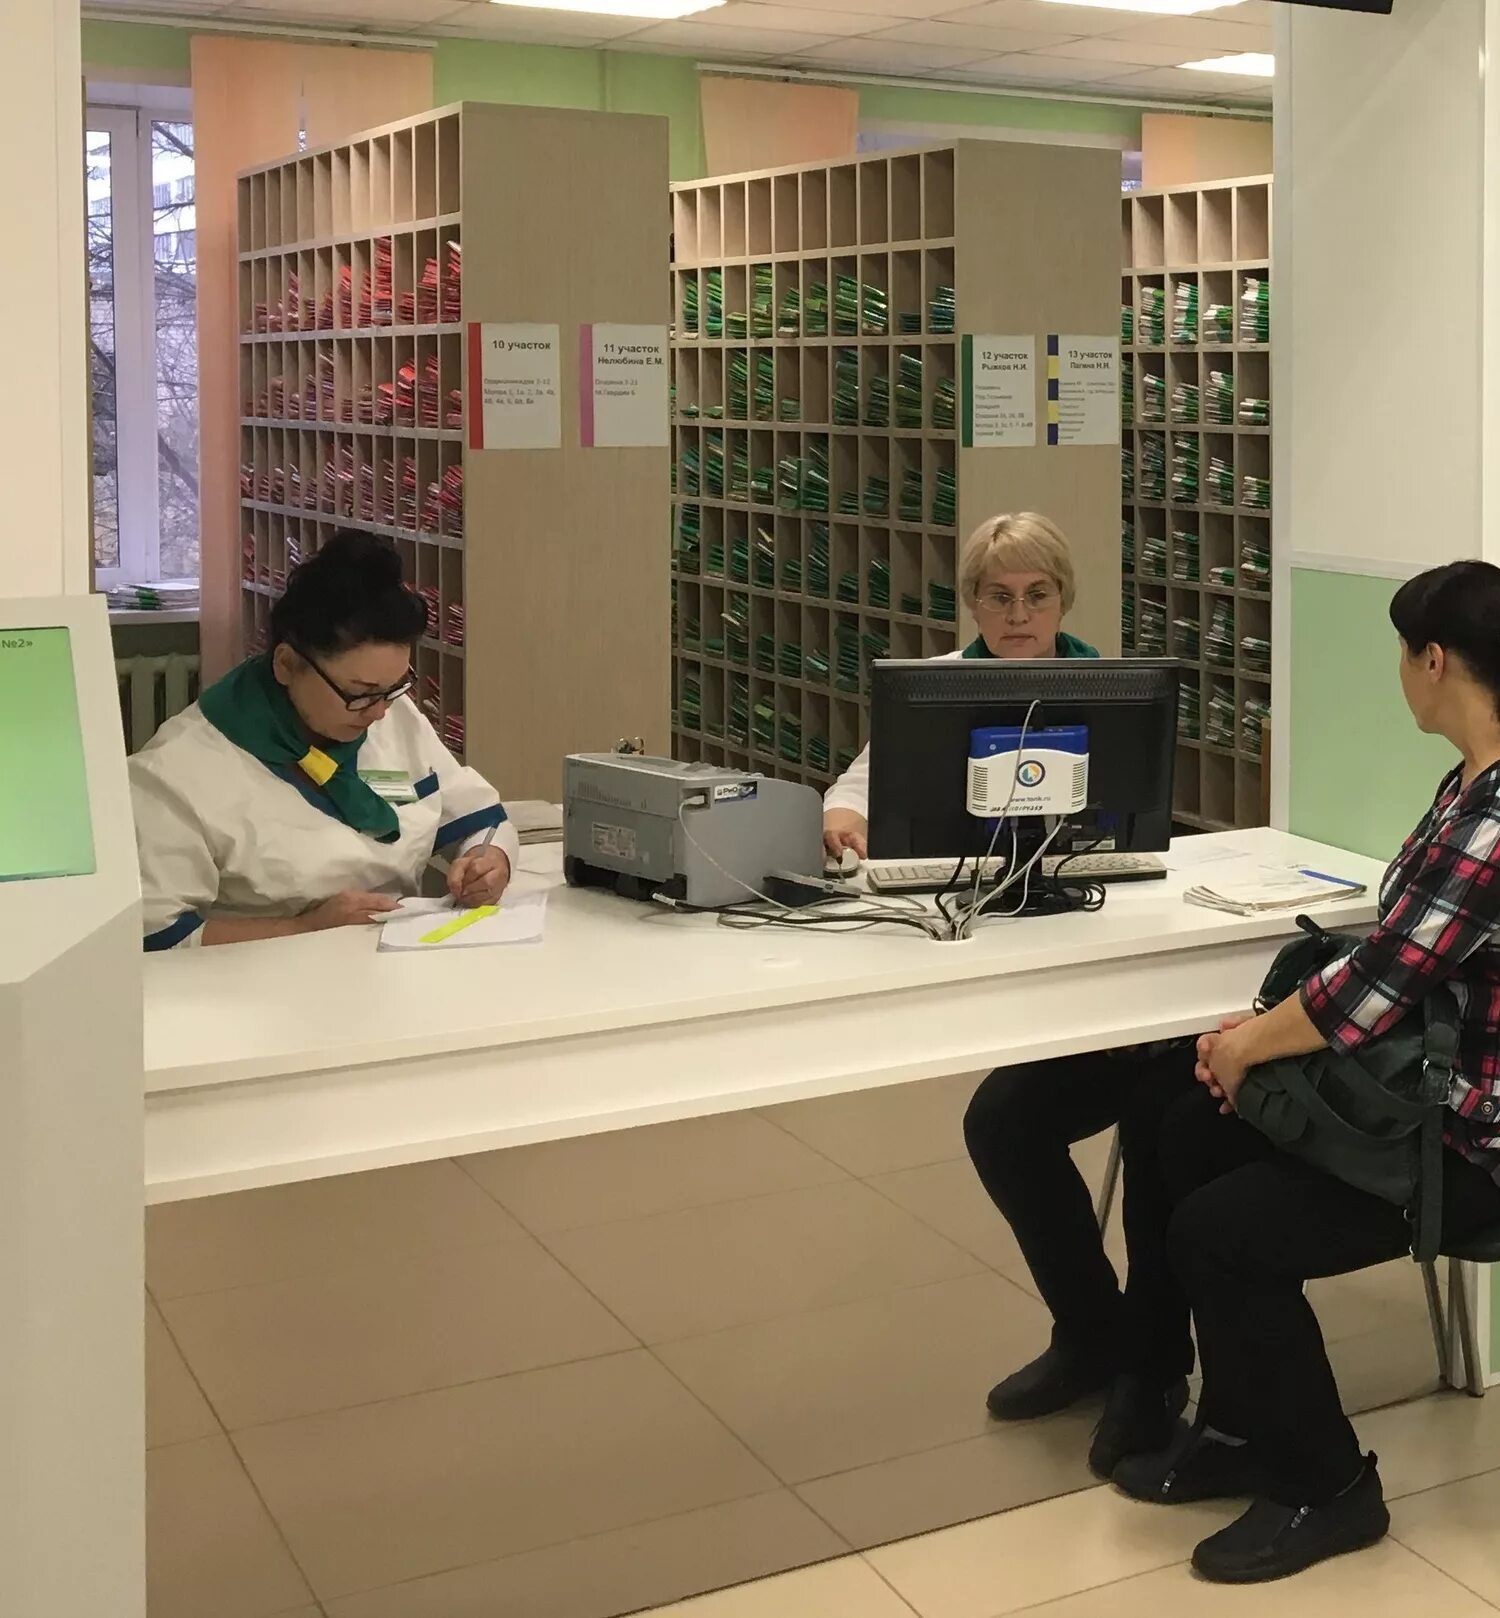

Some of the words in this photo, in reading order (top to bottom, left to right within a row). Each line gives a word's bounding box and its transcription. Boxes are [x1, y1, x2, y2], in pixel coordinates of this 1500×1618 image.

[492, 340, 505, 349] 10
[507, 342, 551, 351] участок
[603, 344, 615, 353] 11
[617, 346, 660, 355] участок
[982, 351, 992, 360] 12
[993, 353, 1029, 361] участок
[1068, 350, 1078, 359] 13
[1079, 352, 1113, 360] участок
[598, 357, 644, 365] Нелюбина
